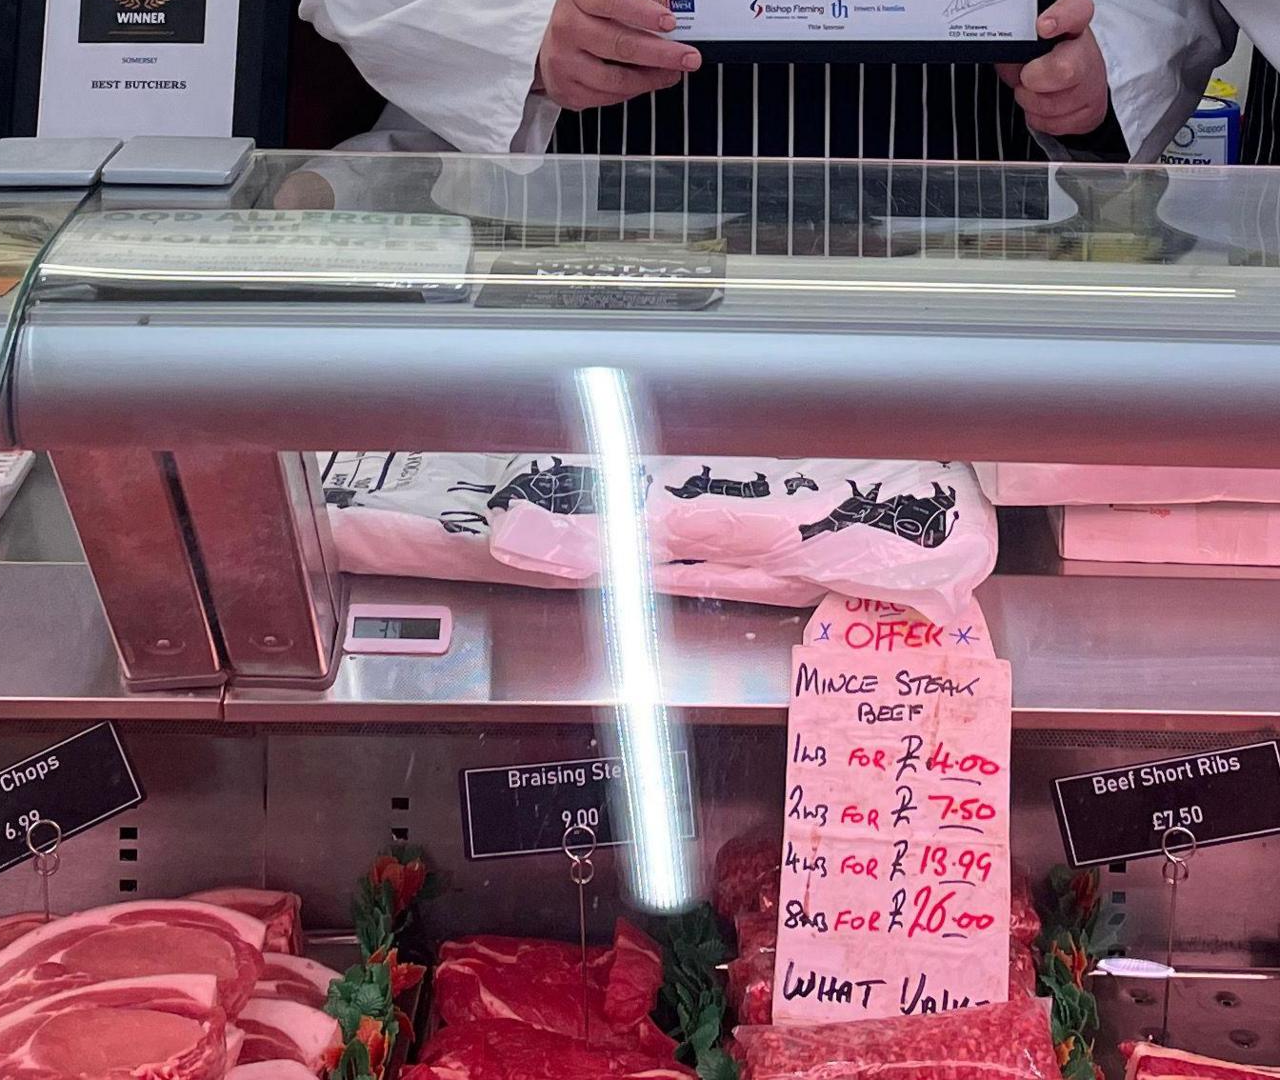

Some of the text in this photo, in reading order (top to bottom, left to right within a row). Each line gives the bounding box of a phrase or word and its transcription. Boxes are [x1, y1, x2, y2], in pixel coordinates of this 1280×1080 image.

[116, 11, 166, 24] WINNER
[671, 1, 693, 10] West
[765, 4, 825, 15] Bishop Fleming
[91, 79, 187, 90] BEST BUTCHERS
[1197, 124, 1226, 133] Support
[225, 211, 464, 227] ALLERGIES
[845, 620, 943, 651] OFFER
[795, 663, 980, 697] MINCE STEAK
[857, 702, 924, 724] BEEF
[0, 751, 62, 794] Chops
[848, 742, 1001, 776] FOR 4.00
[506, 760, 585, 790] Braising
[1091, 753, 1241, 796] Beef Short Ribs
[4, 807, 42, 842] 6.99
[561, 808, 599, 830] 9.00
[841, 795, 996, 831] FOR 7.50
[1152, 805, 1204, 832] £7.50
[840, 845, 992, 882] FOR 13.99
[833, 885, 995, 938] FOR 26.00
[782, 961, 888, 1009] WHAT
